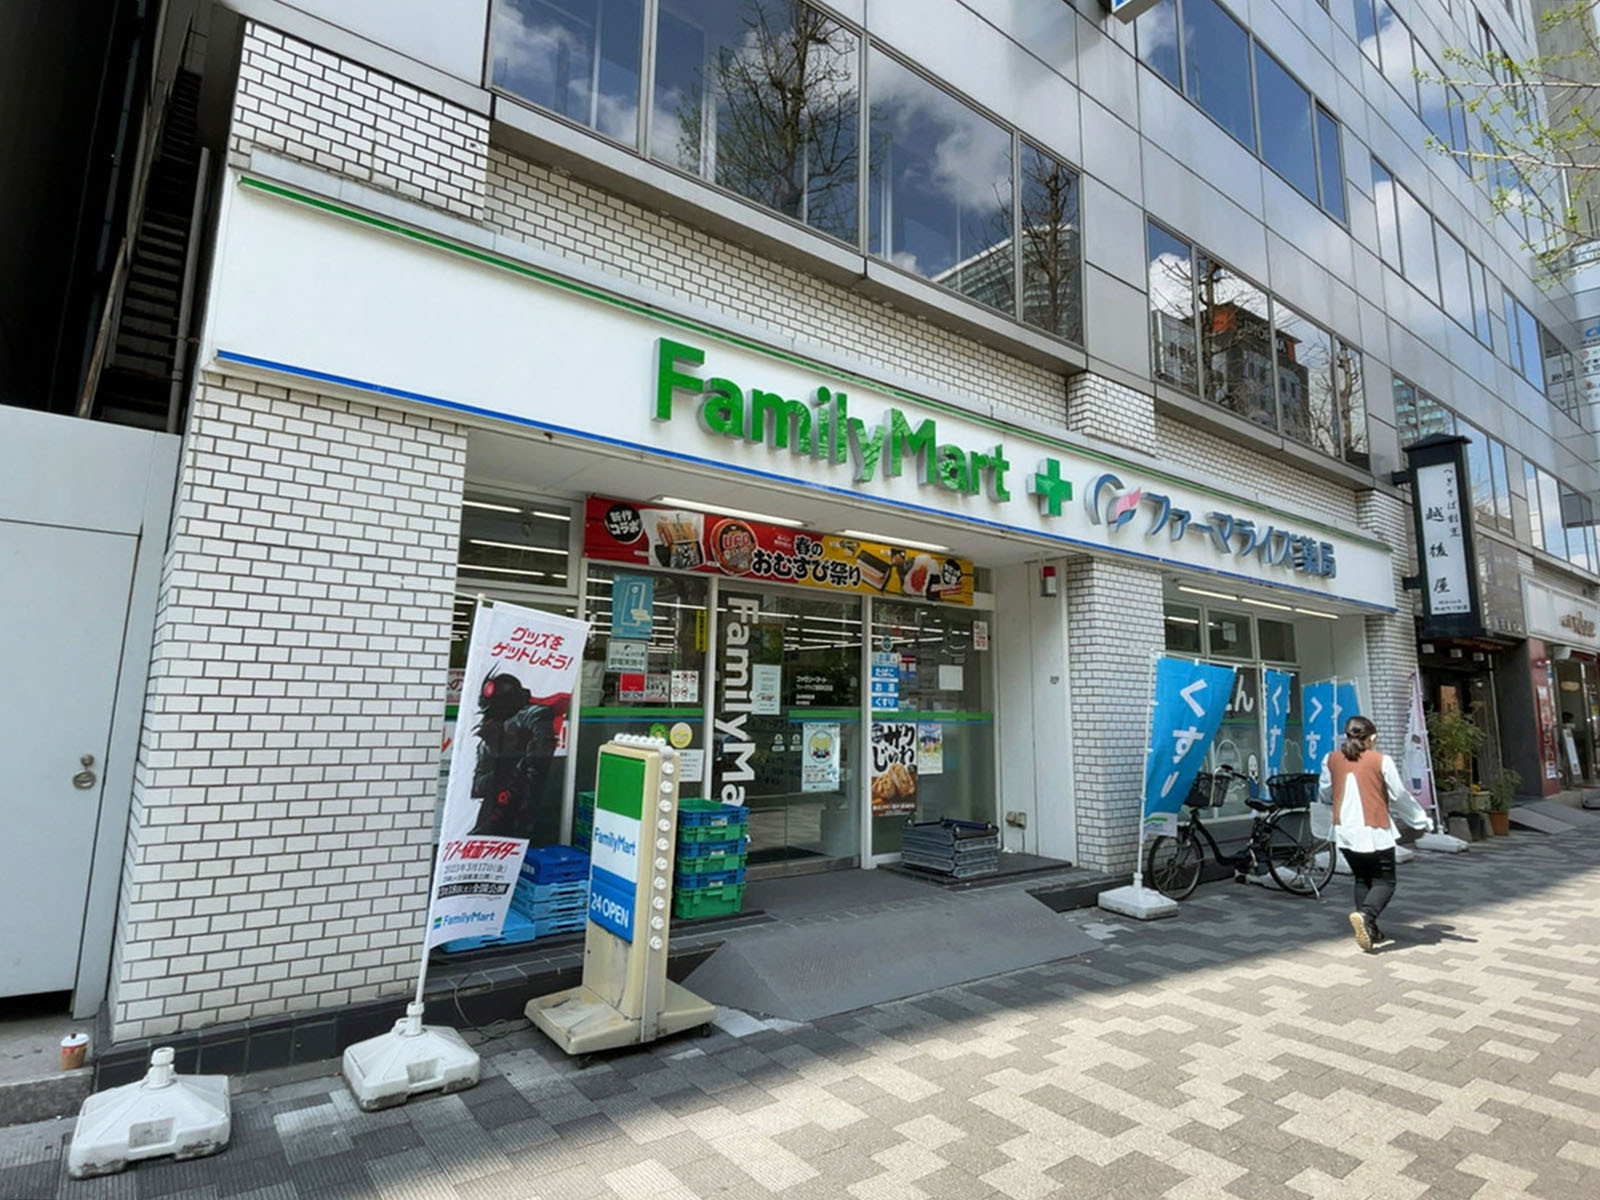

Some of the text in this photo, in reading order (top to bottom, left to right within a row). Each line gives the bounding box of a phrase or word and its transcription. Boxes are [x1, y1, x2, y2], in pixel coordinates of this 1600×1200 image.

[651, 337, 1011, 502] FamilyMart
[609, 519, 640, 535] コラボ
[1141, 491, 1337, 579] ファーマライズ薬局
[796, 536, 823, 557] 春の
[1426, 506, 1452, 594] 越後屋
[752, 550, 862, 587] おむすび祭り
[510, 626, 565, 651] グッズを
[875, 668, 895, 677] たばこ
[714, 596, 760, 807] FamilyMa
[875, 698, 895, 706] くすり
[594, 827, 636, 856] FamilyMart
[443, 911, 495, 926] FamilyMart
[591, 892, 630, 928] 24 OPEN
